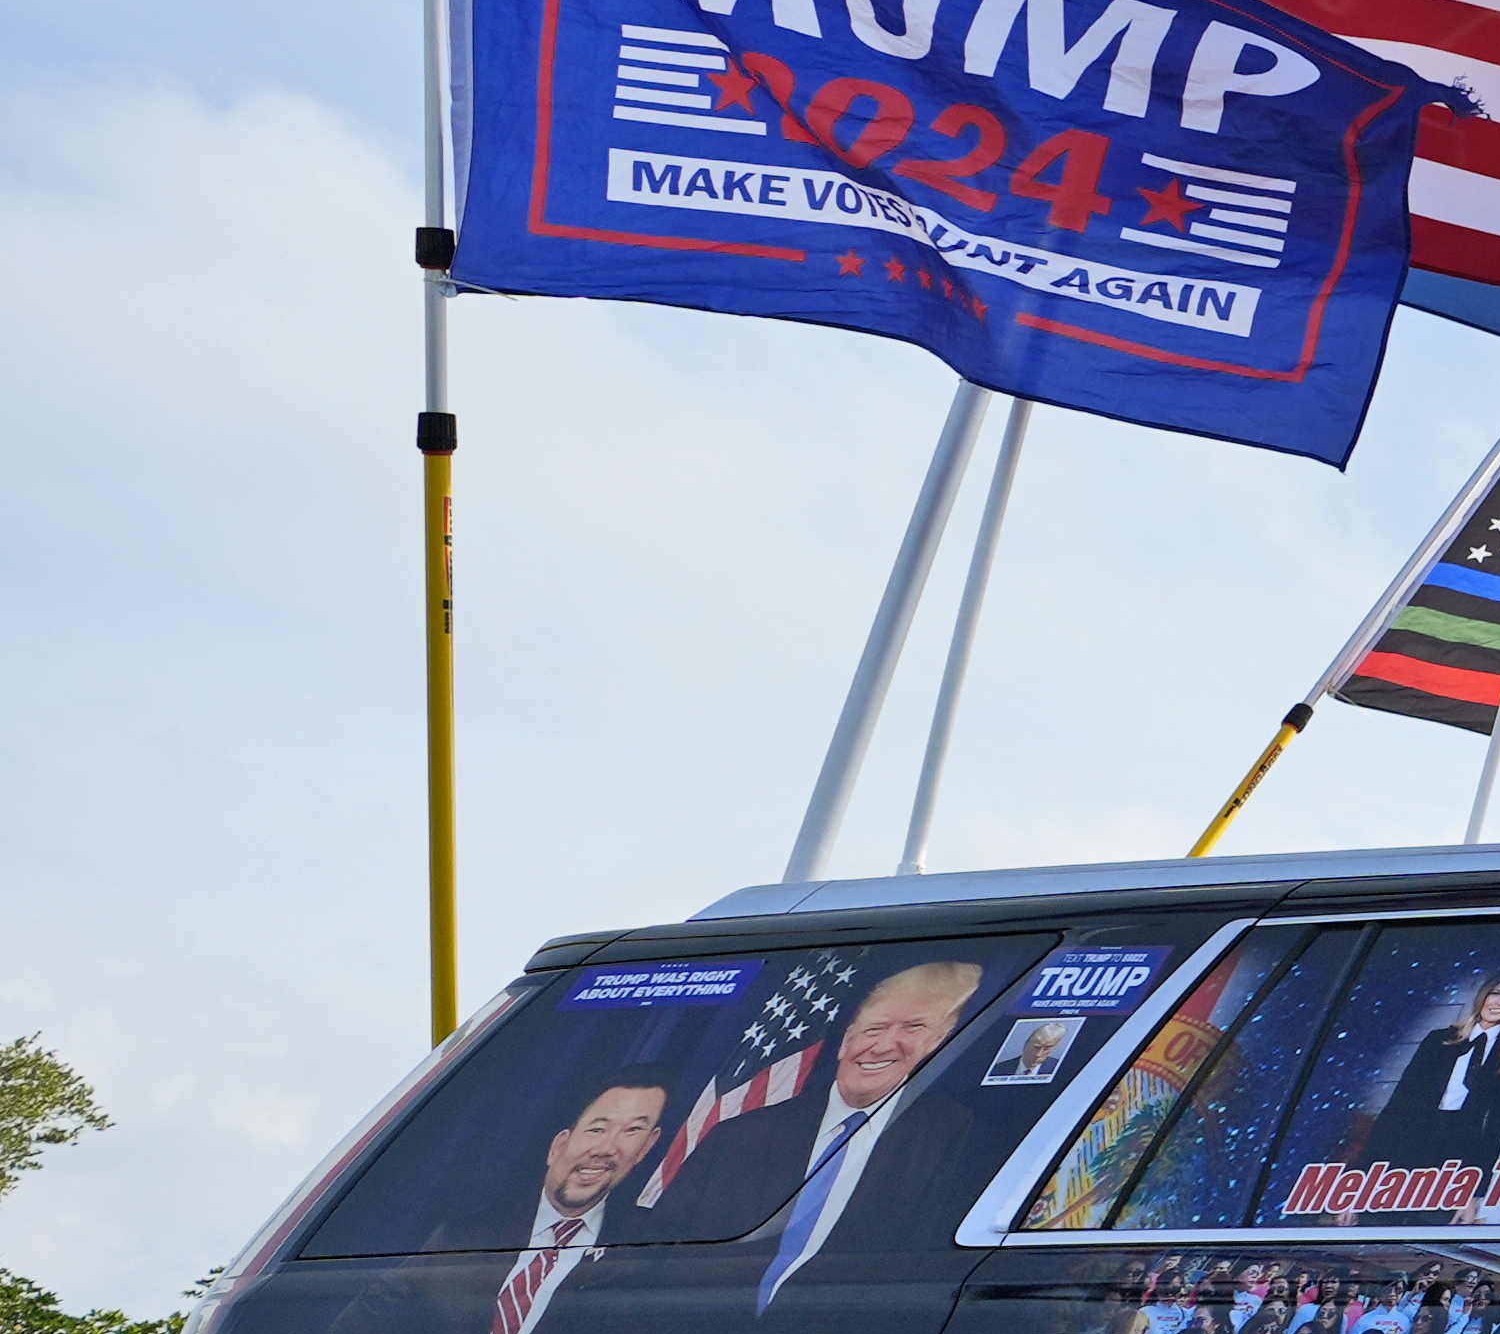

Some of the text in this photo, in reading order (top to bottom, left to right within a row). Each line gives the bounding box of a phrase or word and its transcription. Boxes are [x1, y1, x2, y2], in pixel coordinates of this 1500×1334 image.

[738, 51, 1114, 234] 2024
[630, 159, 1238, 323] MAKE VOTES UNT AGAIN
[573, 983, 737, 1000] ABOUT EVERYTHING
[593, 970, 741, 986] TRUMP WAS RIGHT
[1032, 966, 1151, 997] TRUMP
[1283, 1160, 1483, 1213] Melania
